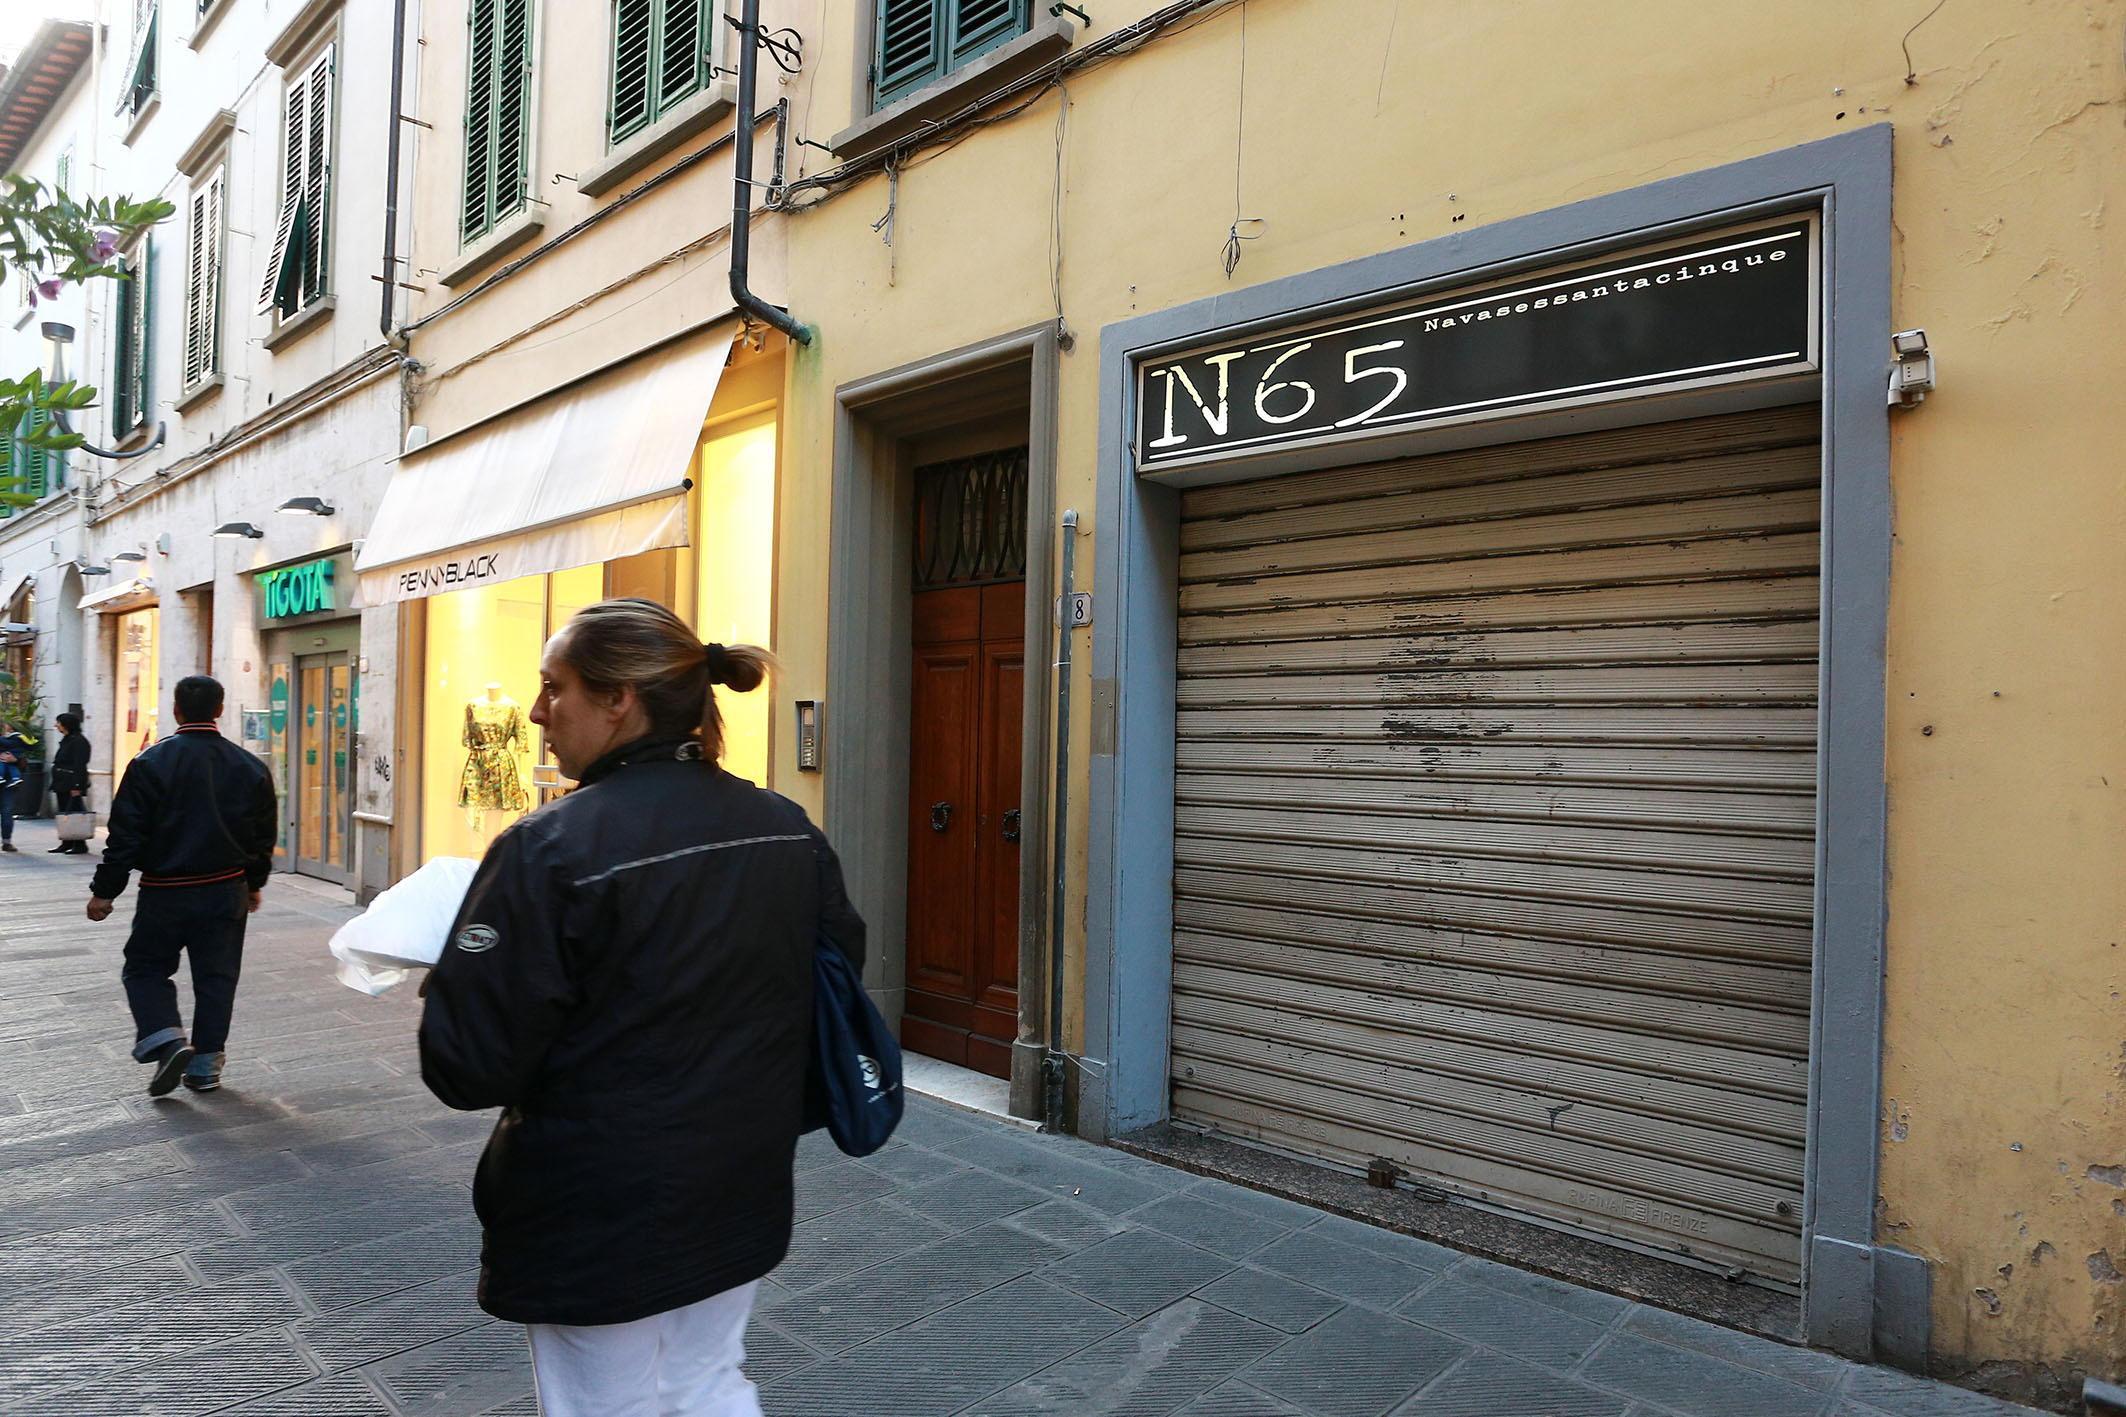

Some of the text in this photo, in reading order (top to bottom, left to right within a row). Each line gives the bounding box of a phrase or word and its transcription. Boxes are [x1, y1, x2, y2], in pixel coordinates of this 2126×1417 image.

[1423, 248, 1788, 333] Navasessantacinque
[398, 552, 499, 594] PENNYBLACK
[1075, 599, 1084, 620] 8
[1651, 1208, 1709, 1235] FIRENZE
